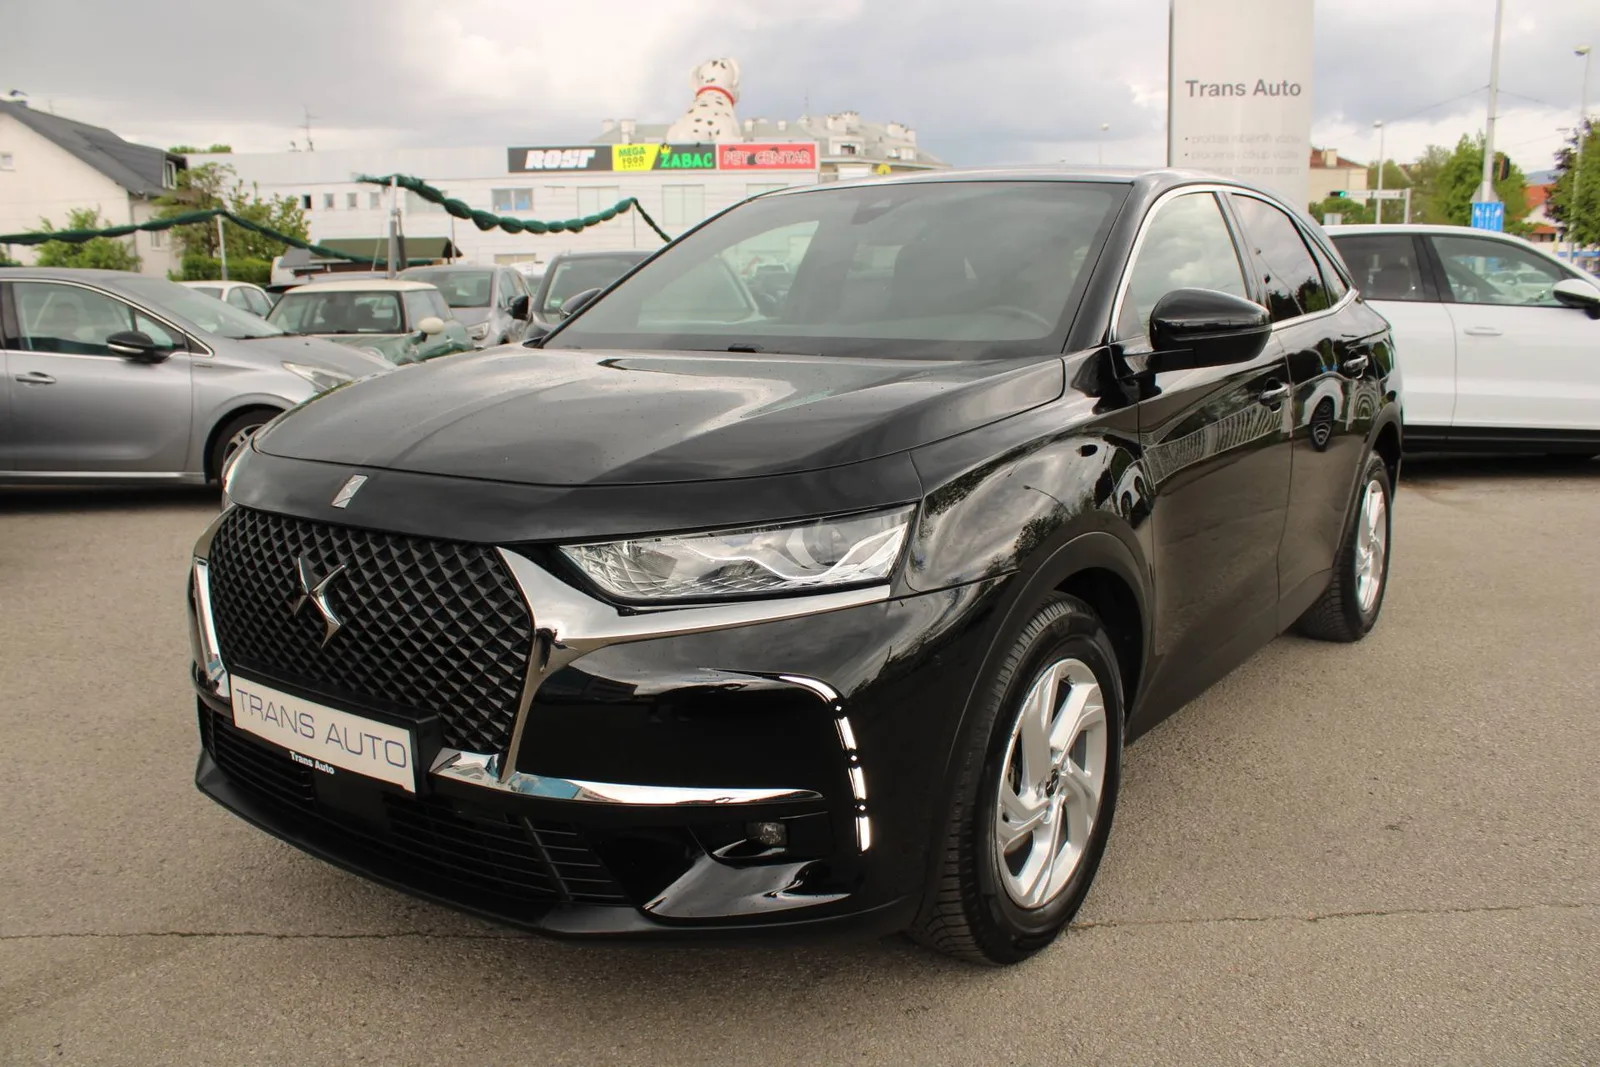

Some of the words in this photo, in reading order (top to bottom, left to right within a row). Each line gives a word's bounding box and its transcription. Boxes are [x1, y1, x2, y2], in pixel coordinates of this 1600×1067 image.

[1185, 80, 1246, 97] Trans
[1253, 79, 1302, 97] Auto
[618, 146, 646, 157] MEGA
[723, 150, 750, 166] PET
[754, 150, 811, 165] CENTAR
[235, 688, 315, 739] TRANS
[325, 723, 407, 769] AUTO
[289, 750, 313, 768] Trans
[314, 760, 335, 775] Auto
